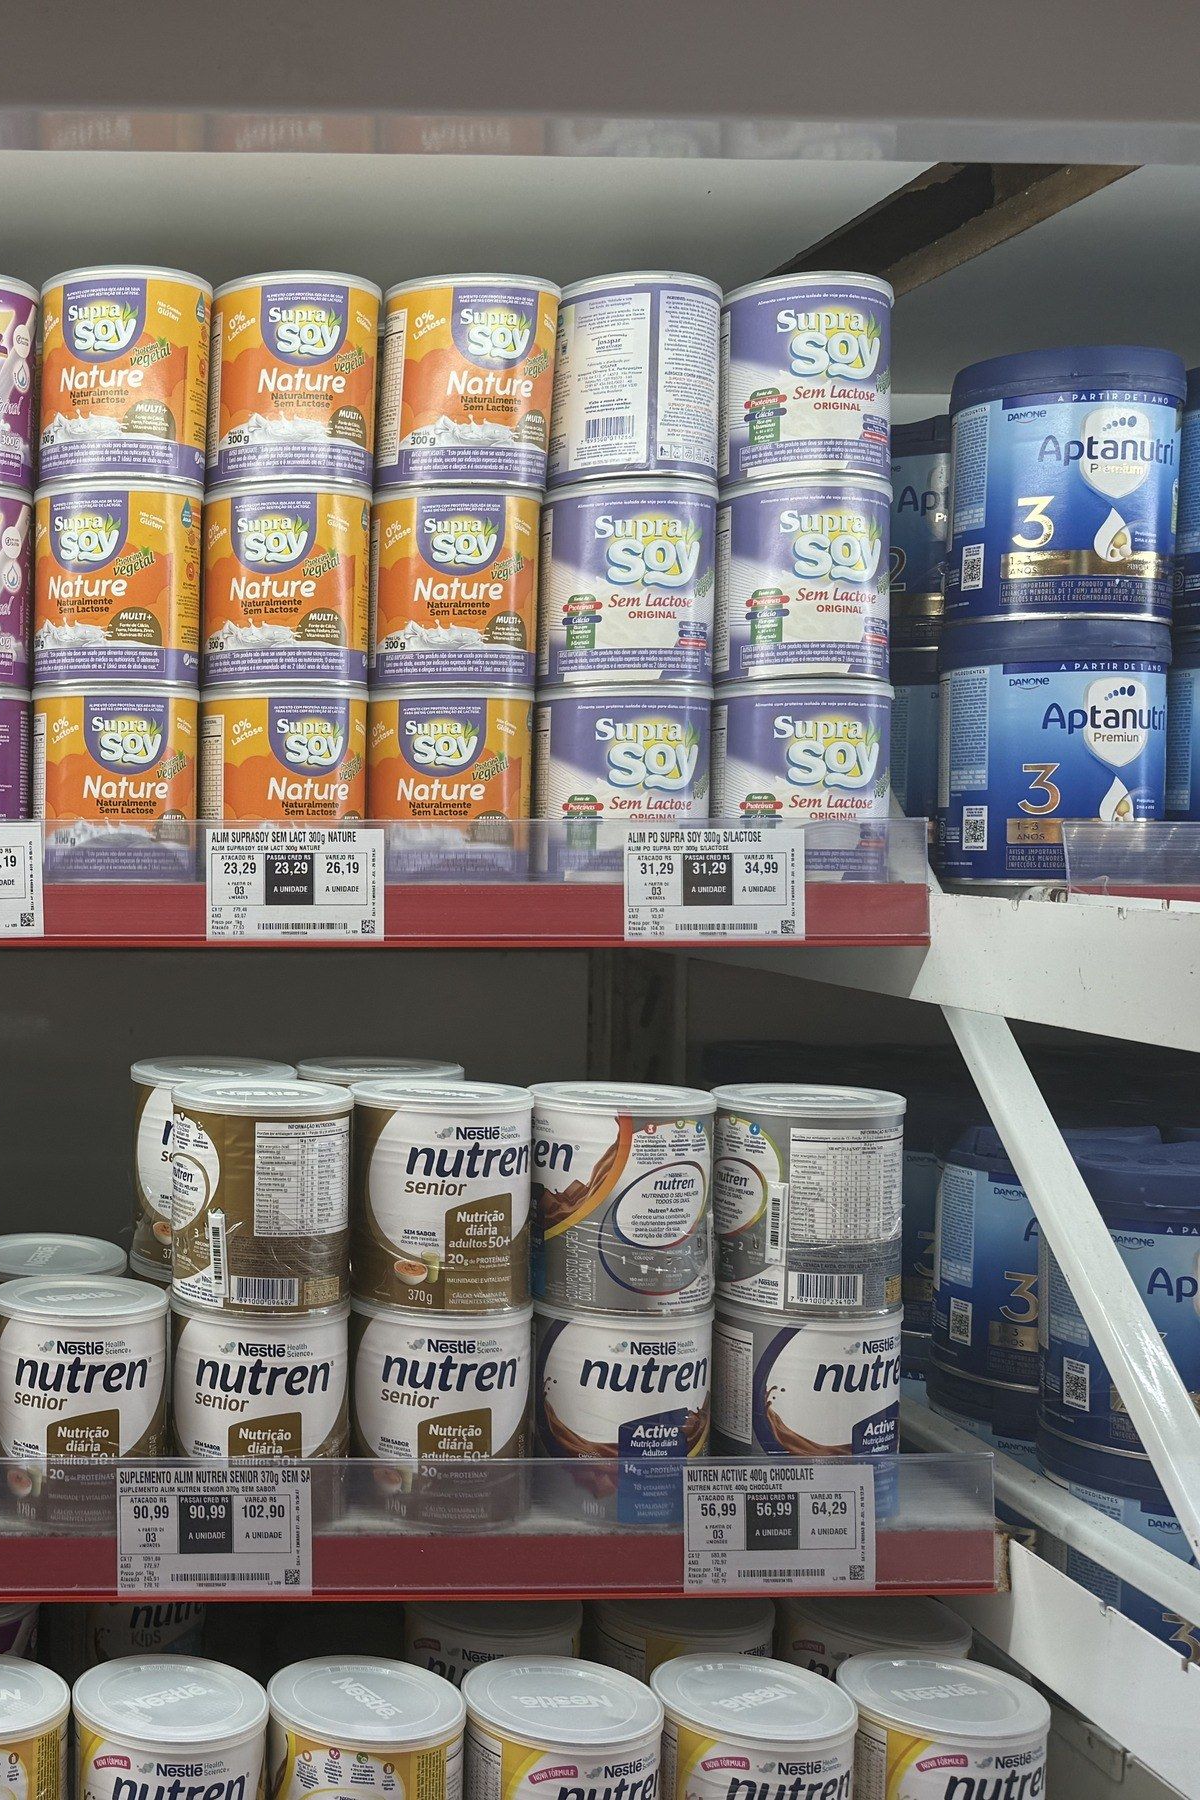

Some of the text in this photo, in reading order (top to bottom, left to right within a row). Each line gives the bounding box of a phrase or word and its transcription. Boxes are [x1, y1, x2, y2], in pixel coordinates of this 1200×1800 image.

[68, 301, 120, 324] Supra
[268, 306, 326, 328] Supra
[775, 309, 864, 334] Supra
[60, 367, 144, 392] Nature
[258, 369, 347, 394] Nature
[446, 371, 534, 398] Nature
[271, 392, 333, 401] Naturalmente
[274, 400, 331, 409] Sem Lactose
[1072, 392, 1118, 402] PARTIR
[1124, 394, 1138, 402] DE
[1152, 396, 1169, 404] ANO
[1038, 434, 1174, 466] Aptanutri
[594, 515, 682, 539] Supra
[608, 593, 693, 609] Sem Lactose
[628, 611, 677, 620] ORIGINAL
[1042, 702, 1166, 734] Aptanutri
[83, 777, 169, 799] Nature
[211, 832, 356, 845] ALIM SUPRASOY SEM LACT 300g NATURE
[628, 832, 761, 844] ALIM PO SUPRA SOY 300g S/LACTOSE
[223, 862, 257, 876] 23,29
[274, 862, 308, 876] 23,29
[326, 862, 359, 876] 26,19
[641, 862, 674, 876] 31,29
[693, 862, 727, 876] 31,29
[745, 861, 778, 875] 34,99
[234, 886, 244, 895] 03
[455, 1126, 500, 1140] Nestlé
[405, 1143, 529, 1179] nutren
[404, 1180, 467, 1197] senior
[456, 1210, 505, 1227] Nutrição
[465, 1223, 498, 1237] diária
[196, 1358, 331, 1396] nutren
[579, 1356, 708, 1393] nutren
[632, 1424, 679, 1439] Active
[119, 1470, 171, 1484] SUPLEMENTO
[174, 1470, 193, 1484] ALIM
[195, 1470, 227, 1484] NUTREN
[229, 1470, 258, 1484] SENIOR
[260, 1470, 279, 1485] 370g
[282, 1470, 298, 1483] SEM
[687, 1468, 814, 1484] NUTREN ACTIVE 400g CHOCOLATE
[133, 1505, 169, 1521] 90,99
[242, 1504, 285, 1519] 102,90
[701, 1503, 737, 1518] 56,99
[812, 1501, 847, 1517] 64,29
[155, 1762, 203, 1779] Nestlé
[777, 1759, 823, 1776] Nestlé
